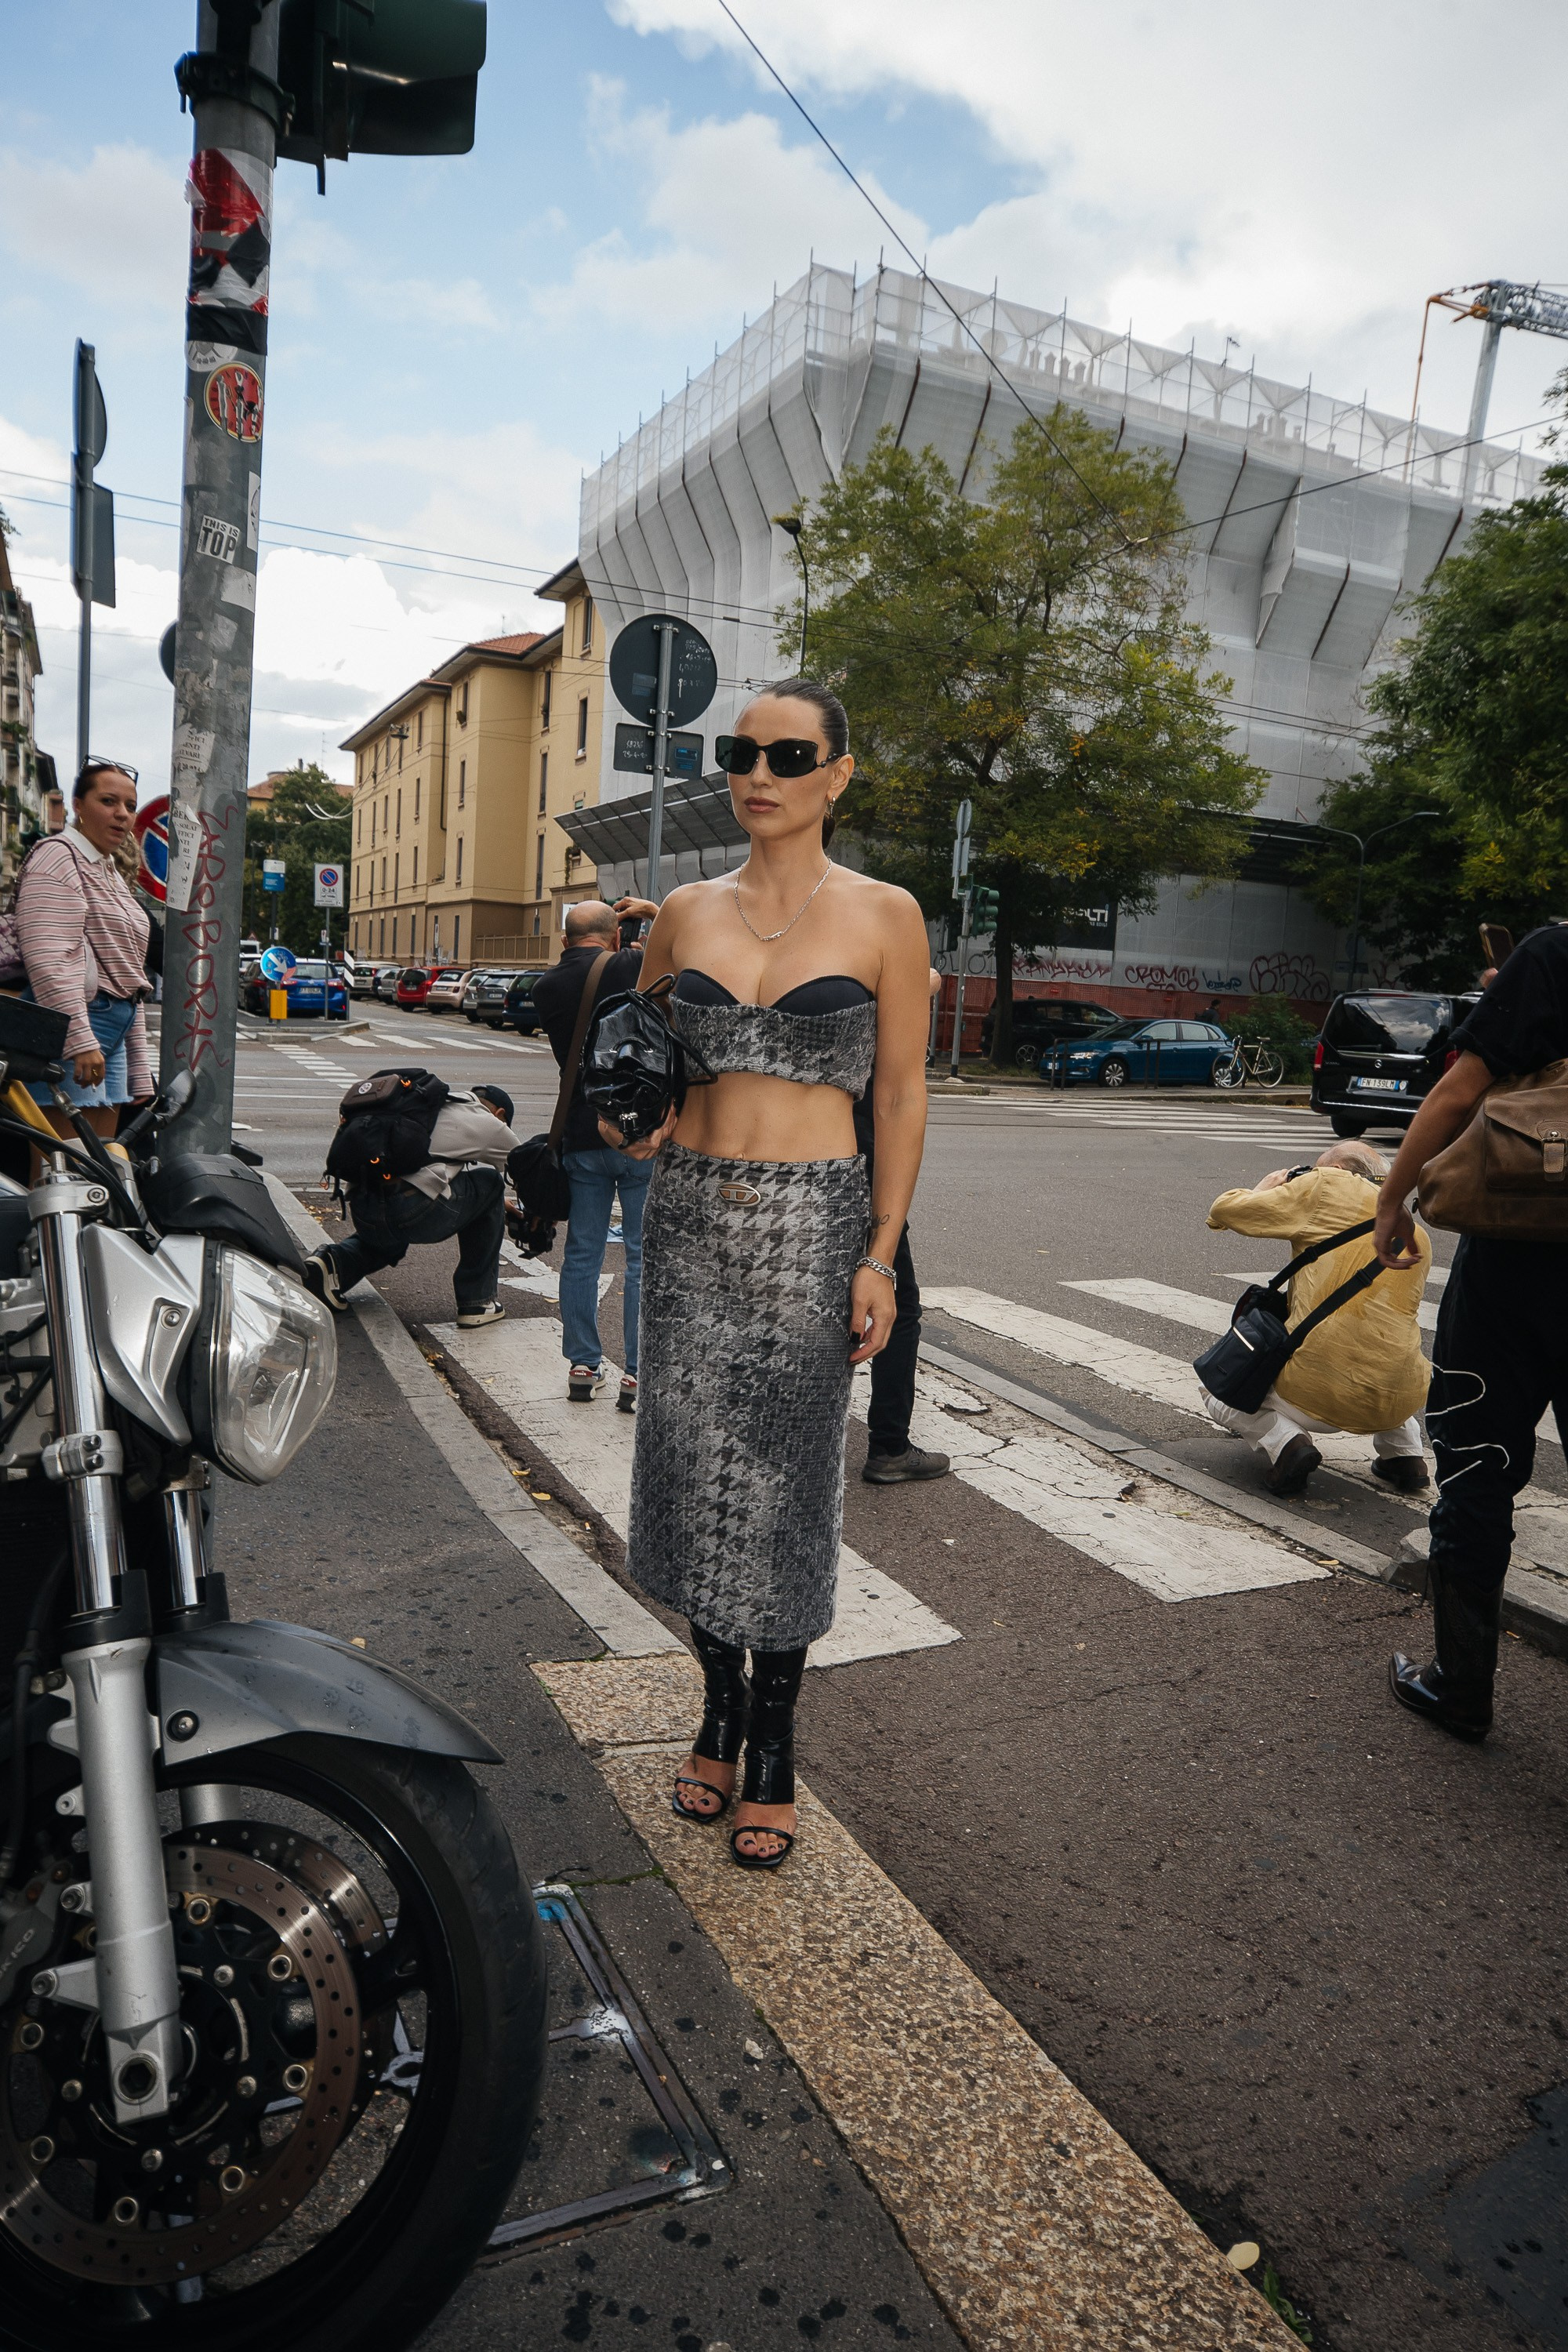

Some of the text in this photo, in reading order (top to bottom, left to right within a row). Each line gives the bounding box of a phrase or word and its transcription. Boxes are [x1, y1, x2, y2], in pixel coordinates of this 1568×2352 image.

[204, 517, 239, 538] THIS IS
[201, 526, 237, 560] TOP
